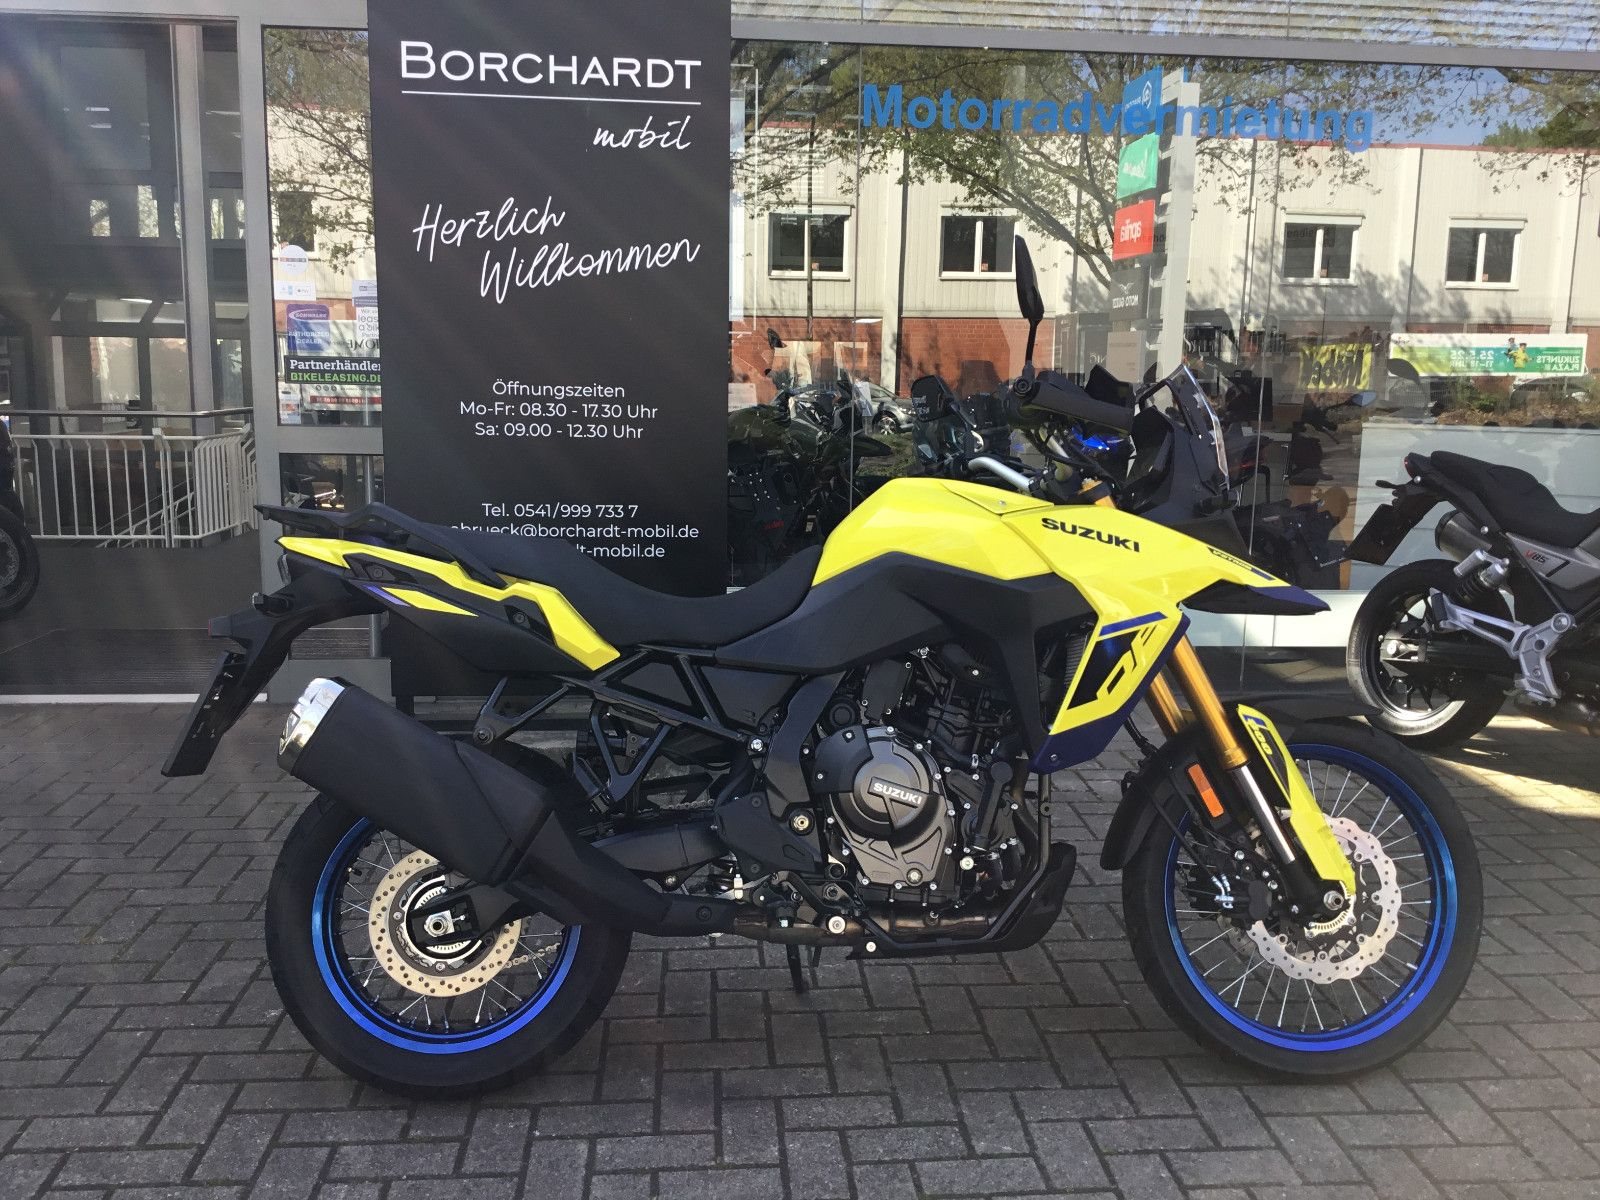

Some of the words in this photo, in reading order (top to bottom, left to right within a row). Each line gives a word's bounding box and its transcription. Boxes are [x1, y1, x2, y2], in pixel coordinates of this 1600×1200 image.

[400, 40, 702, 89] BORCHARDT
[862, 83, 1376, 153] Motorradvermietung
[592, 115, 692, 150] mobil
[412, 195, 566, 263] Herzlich
[479, 238, 701, 304] Willkommen
[491, 379, 626, 399] Öffnungszeiten
[459, 401, 516, 417] Mo-Fr:
[520, 402, 567, 417] 08.30
[582, 403, 624, 418] 17.30
[626, 404, 659, 419] Uhr
[474, 422, 500, 436] Sa:
[503, 423, 552, 437] 09.00
[566, 424, 608, 438] 12.30
[612, 425, 644, 439] Uhr
[481, 502, 510, 517] Tel.
[513, 503, 592, 519] 0541/999
[595, 503, 625, 518] 733
[450, 524, 699, 538] breck@borchardt-mobil.de
[1041, 517, 1141, 553] SUZUKI
[873, 782, 922, 804] SUZUKI
